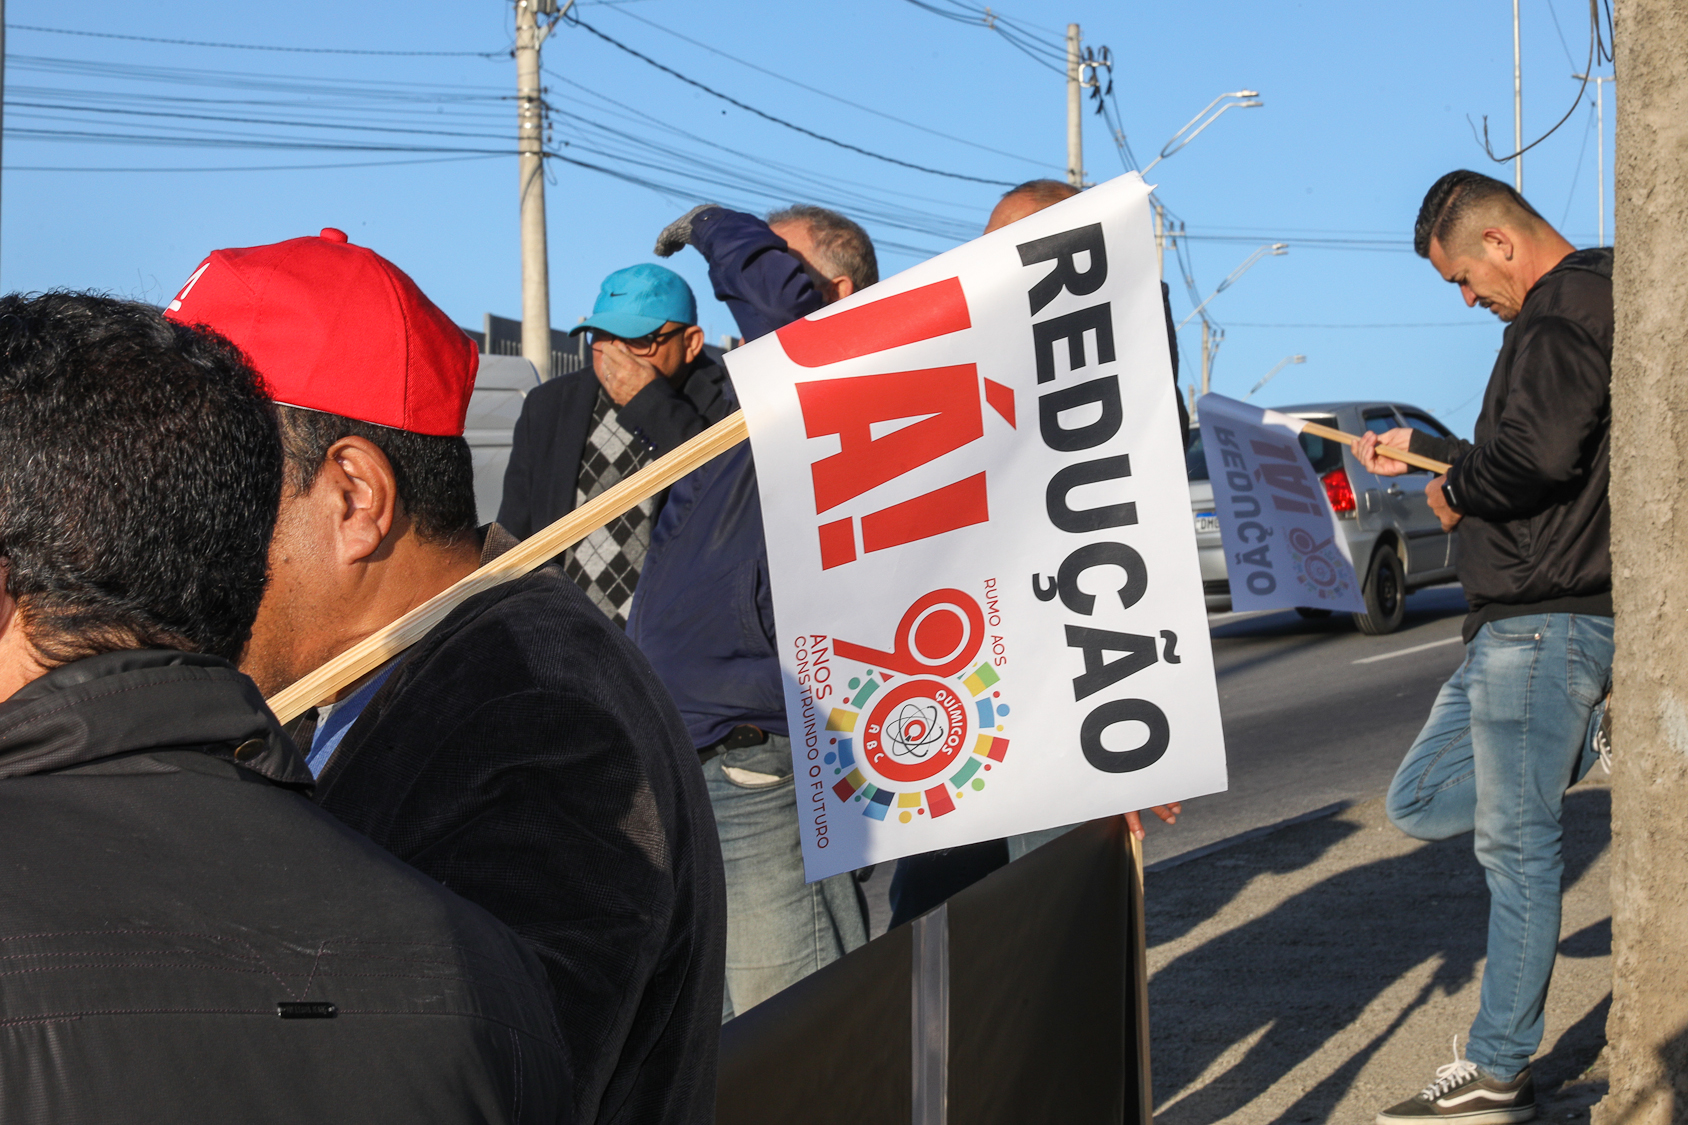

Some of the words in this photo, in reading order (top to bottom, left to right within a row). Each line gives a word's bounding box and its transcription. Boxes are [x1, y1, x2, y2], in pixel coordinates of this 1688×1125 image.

[776, 276, 1017, 571] JÁ!
[1016, 222, 1181, 774] REDUÇÃO
[983, 577, 1002, 627] RUMO
[809, 634, 833, 700] ANOS
[990, 634, 1008, 667] AOS
[794, 636, 820, 761] CONSTRUINDO
[935, 689, 964, 756] QUÍMICOS
[808, 764, 822, 778] O
[810, 780, 830, 850] FUTURO
